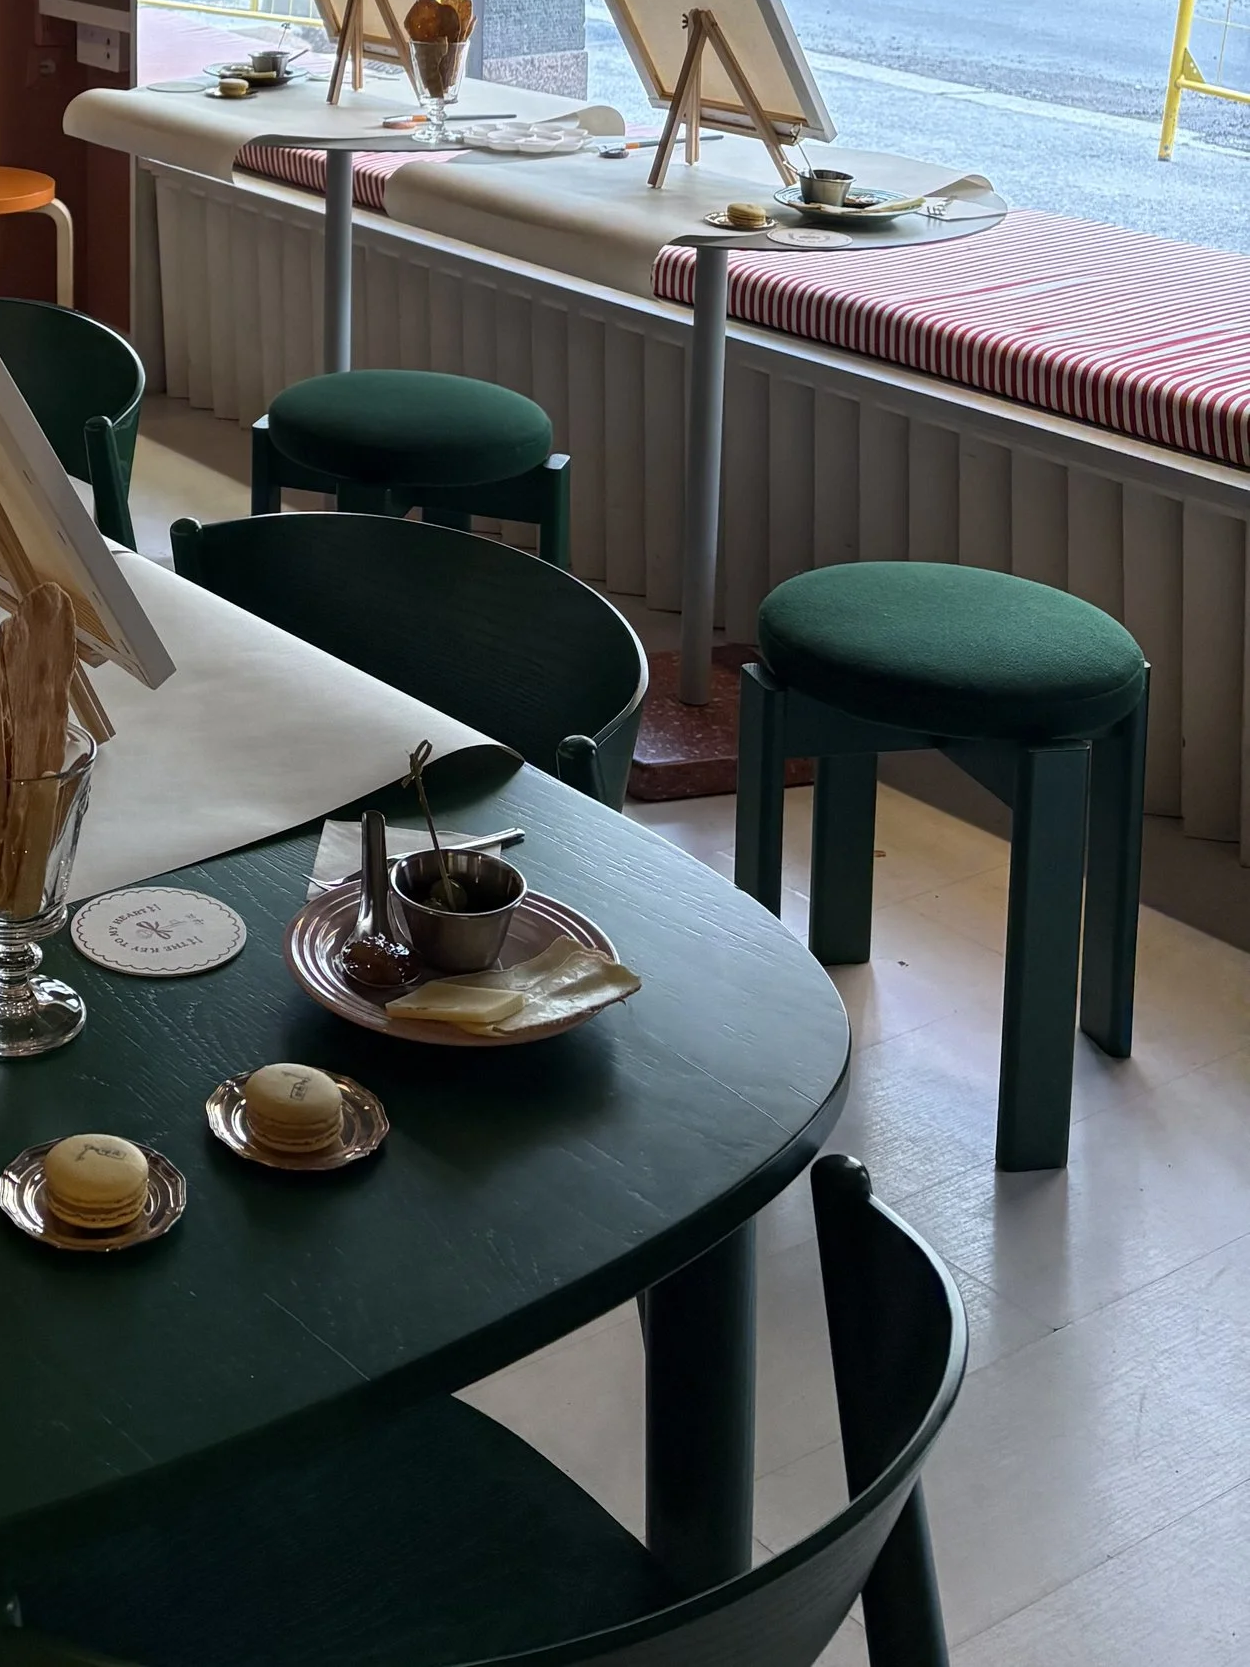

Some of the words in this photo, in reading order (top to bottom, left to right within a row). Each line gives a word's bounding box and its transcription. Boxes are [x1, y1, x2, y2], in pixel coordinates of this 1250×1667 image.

[112, 906, 148, 925] HEART
[108, 925, 119, 937] MY
[114, 937, 130, 948] TO
[162, 941, 189, 952] THE
[131, 945, 160, 954] KEY
